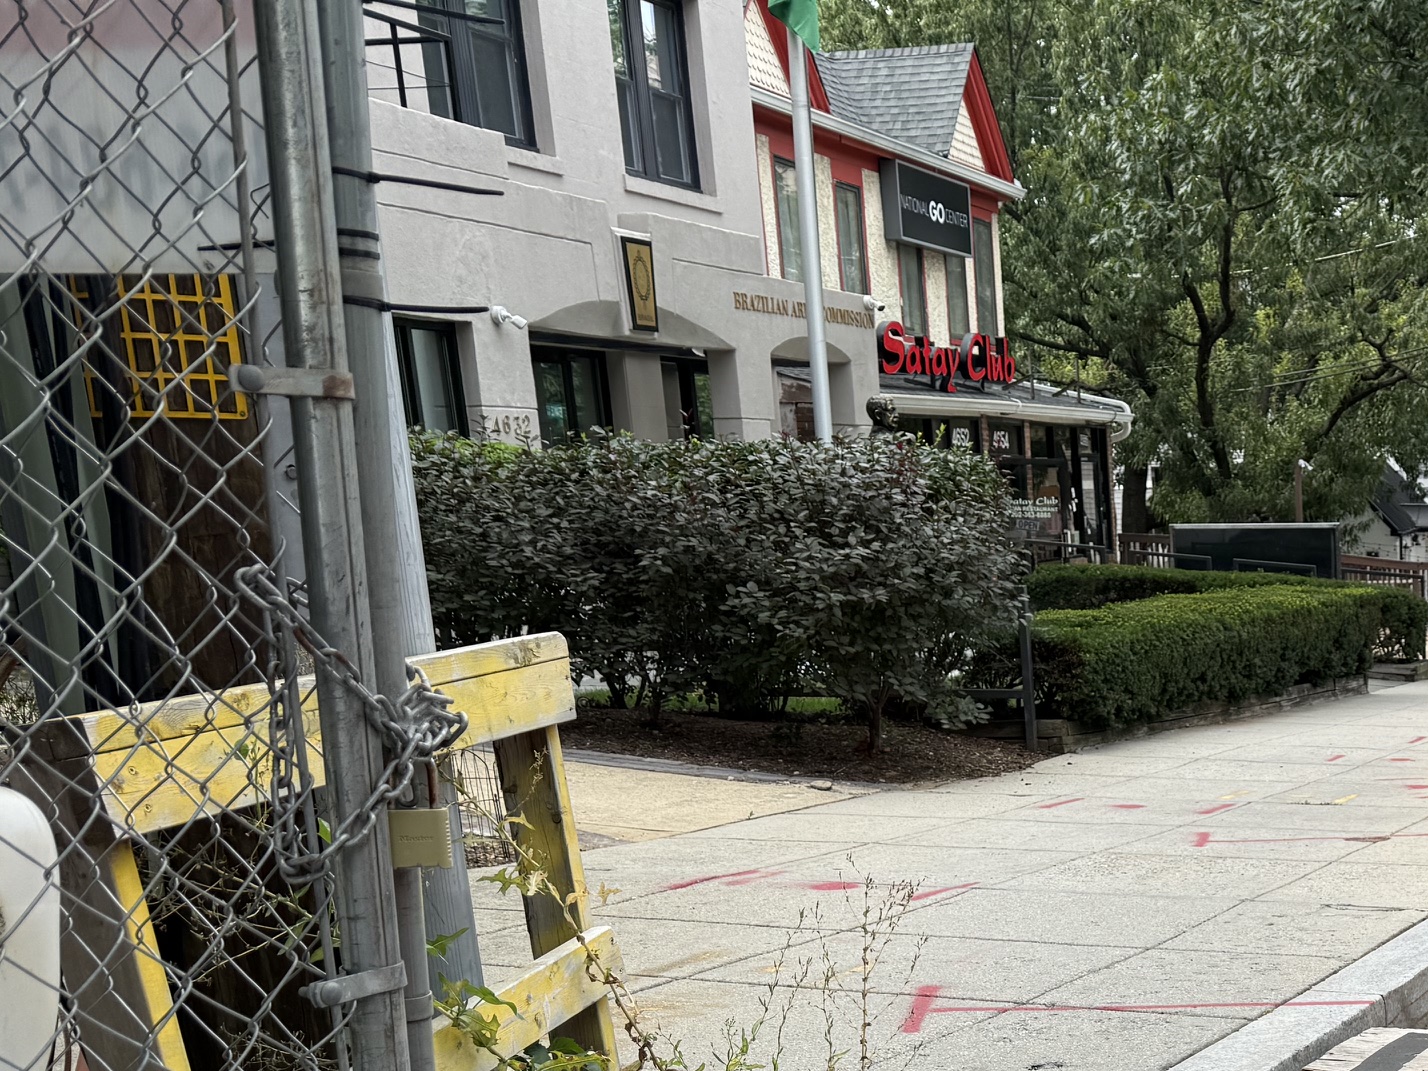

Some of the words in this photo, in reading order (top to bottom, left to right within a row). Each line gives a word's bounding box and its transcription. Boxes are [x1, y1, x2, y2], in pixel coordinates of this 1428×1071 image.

[900, 194, 929, 217] NATIONAL
[929, 200, 945, 224] GO
[945, 208, 968, 228] CENTER
[733, 291, 788, 316] BRAZILIAN
[882, 321, 960, 393] Satay
[967, 332, 1016, 384] Club
[491, 414, 532, 436] 4632
[952, 427, 970, 447] 4652
[1036, 496, 1059, 506] Club
[1018, 520, 1039, 530] OPEN
